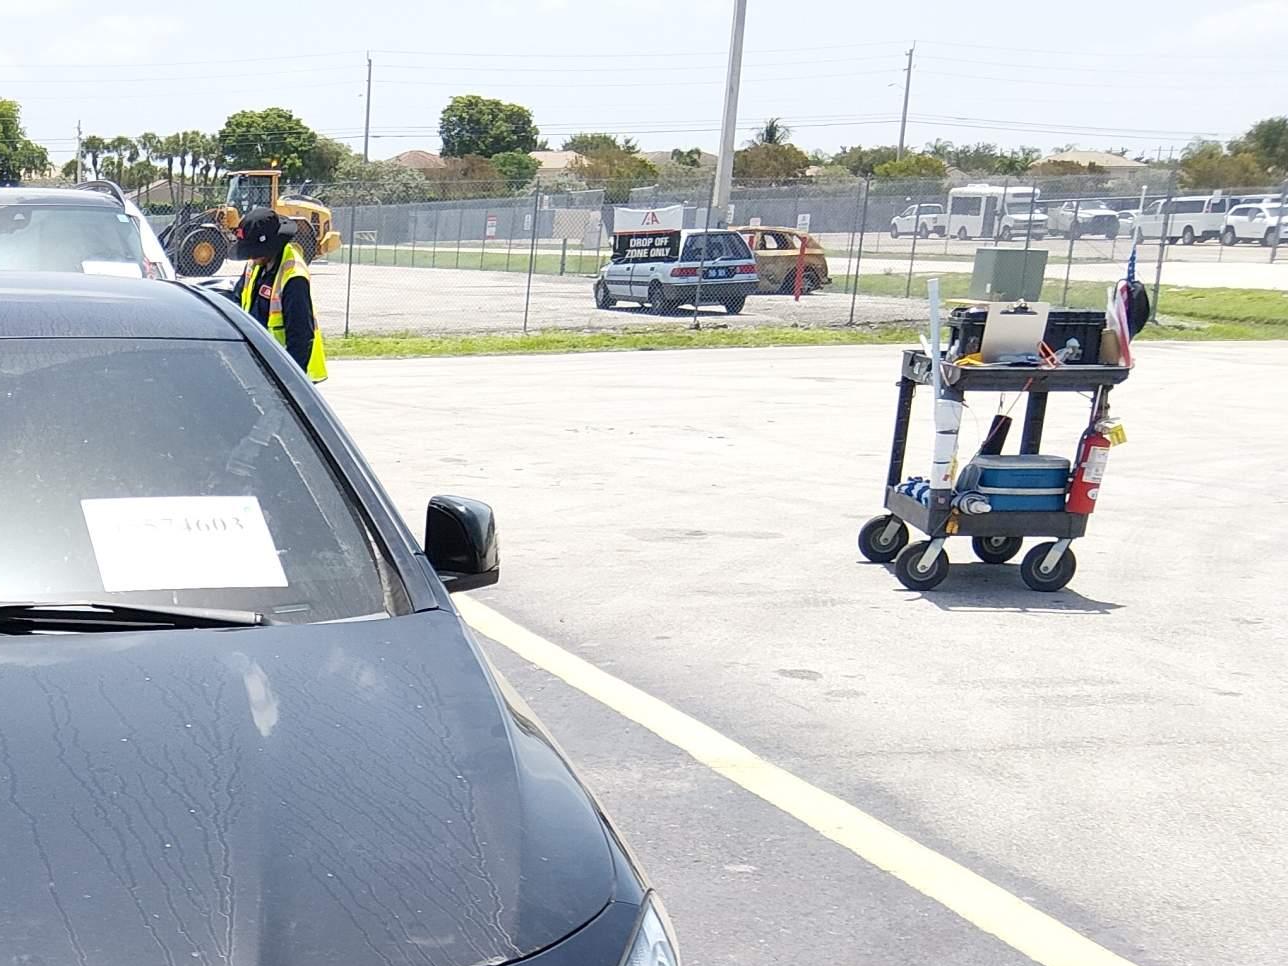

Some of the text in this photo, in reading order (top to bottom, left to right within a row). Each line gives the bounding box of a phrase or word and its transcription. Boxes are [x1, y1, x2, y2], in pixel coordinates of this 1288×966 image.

[629, 237, 670, 248] DROP OFF
[625, 247, 671, 259] ZONE ONLY
